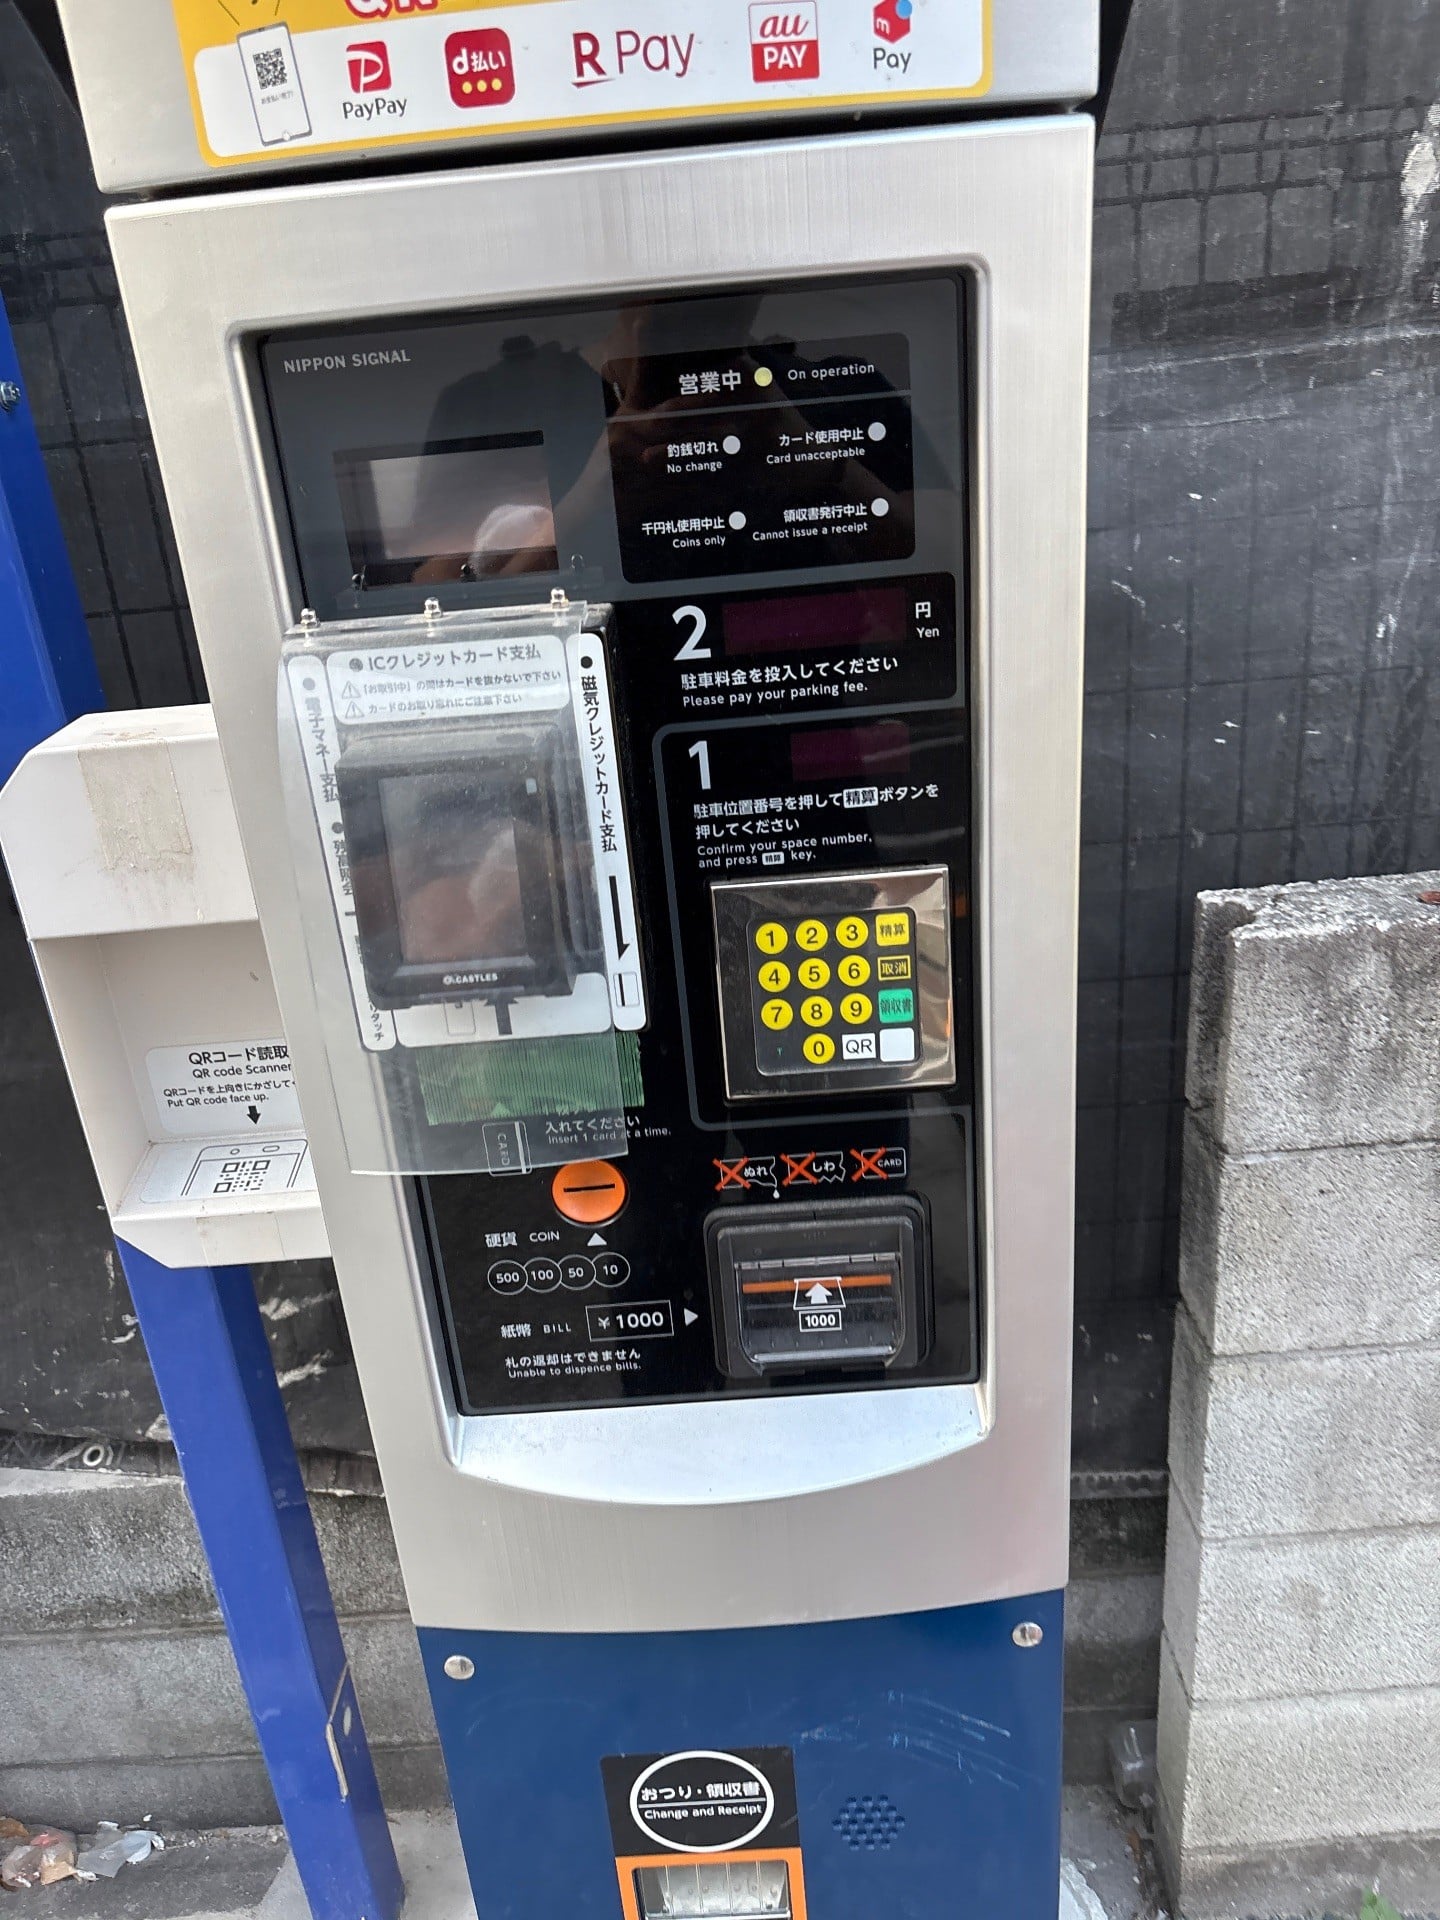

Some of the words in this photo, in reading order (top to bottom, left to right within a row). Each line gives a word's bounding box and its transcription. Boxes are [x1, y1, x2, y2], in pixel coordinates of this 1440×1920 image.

[759, 13, 808, 38] au
[452, 48, 507, 75] d払い
[615, 29, 695, 79] Pay
[763, 44, 808, 71] PAY
[873, 47, 912, 74] Pay
[342, 97, 408, 120] PayPay
[284, 354, 346, 373] NIPPON
[352, 349, 411, 367] SIGNAL
[787, 369, 807, 381] On
[812, 363, 875, 380] operation
[678, 369, 742, 396] 営業中
[779, 427, 865, 447] カード使用中止
[667, 440, 719, 459] 釣銭切れ
[766, 452, 791, 464] Card
[795, 446, 866, 463] unacceptable
[667, 462, 682, 473] No
[686, 460, 723, 472] change
[784, 502, 868, 523] 領収書発行中止
[642, 515, 725, 536] 千円札使用中止
[752, 529, 789, 541] Cannot
[792, 525, 818, 537] issue
[831, 522, 868, 535] receipt
[672, 536, 701, 548] Coins
[704, 535, 726, 548] only
[915, 601, 932, 619] 円
[672, 604, 711, 661] 2
[916, 627, 940, 638] Yen
[369, 643, 542, 671] ICクレジットカード支払
[681, 656, 899, 690] 駐車料金を投入してください
[683, 692, 724, 707] Please
[729, 692, 751, 704] pay
[757, 689, 785, 703] your
[790, 682, 839, 699] parking
[844, 680, 868, 693] fee.
[581, 675, 617, 853] 磁気クレジットカード支払
[689, 740, 711, 791] 1
[695, 817, 800, 840] 押してください
[697, 842, 745, 857] Confirm
[750, 841, 776, 856] your
[781, 837, 817, 852] space
[791, 849, 817, 862] key.
[698, 857, 721, 868] and
[725, 855, 758, 868] press
[766, 931, 775, 947] 1
[806, 928, 818, 944] 2
[846, 925, 859, 941] 3
[456, 972, 498, 984] CASTLES
[768, 969, 781, 985] 4
[808, 966, 821, 982] 5
[848, 963, 861, 979] 6
[771, 1006, 783, 1023] 7
[810, 1003, 823, 1020] 8
[850, 1000, 863, 1017] 9
[813, 1041, 825, 1057] 0
[845, 1038, 873, 1054] QR
[192, 1068, 210, 1079] QR
[214, 1066, 243, 1077] code
[246, 1062, 292, 1075] Scanner
[167, 1098, 184, 1108] Put
[186, 1097, 201, 1107] QR
[204, 1095, 228, 1105] code
[229, 1094, 250, 1103] face
[253, 1093, 269, 1103] up.
[545, 1115, 641, 1135] 入れてください
[548, 1134, 578, 1145] Insert
[592, 1130, 617, 1141] card
[644, 1126, 671, 1137] time.
[496, 1133, 511, 1166] CARD
[744, 1165, 768, 1177] ぬれ
[812, 1160, 836, 1173] しわ
[877, 1157, 902, 1168] CARD
[484, 1231, 518, 1248] 硬貨
[529, 1230, 561, 1242] COIN
[496, 1271, 520, 1284] 500
[530, 1269, 554, 1281] 100
[568, 1266, 584, 1278] 50
[603, 1263, 619, 1276] 10
[543, 1322, 572, 1334] BILL
[804, 1313, 836, 1328] 1000
[505, 1348, 641, 1368] 札の返却はできません
[508, 1368, 546, 1379] Unable
[550, 1367, 561, 1376] to
[565, 1364, 612, 1376] dispence
[615, 1361, 642, 1371] bills.
[641, 1781, 760, 1801] おつり・領収書
[644, 1807, 689, 1820] Change
[692, 1806, 715, 1817] and
[718, 1804, 762, 1817] Receipt
